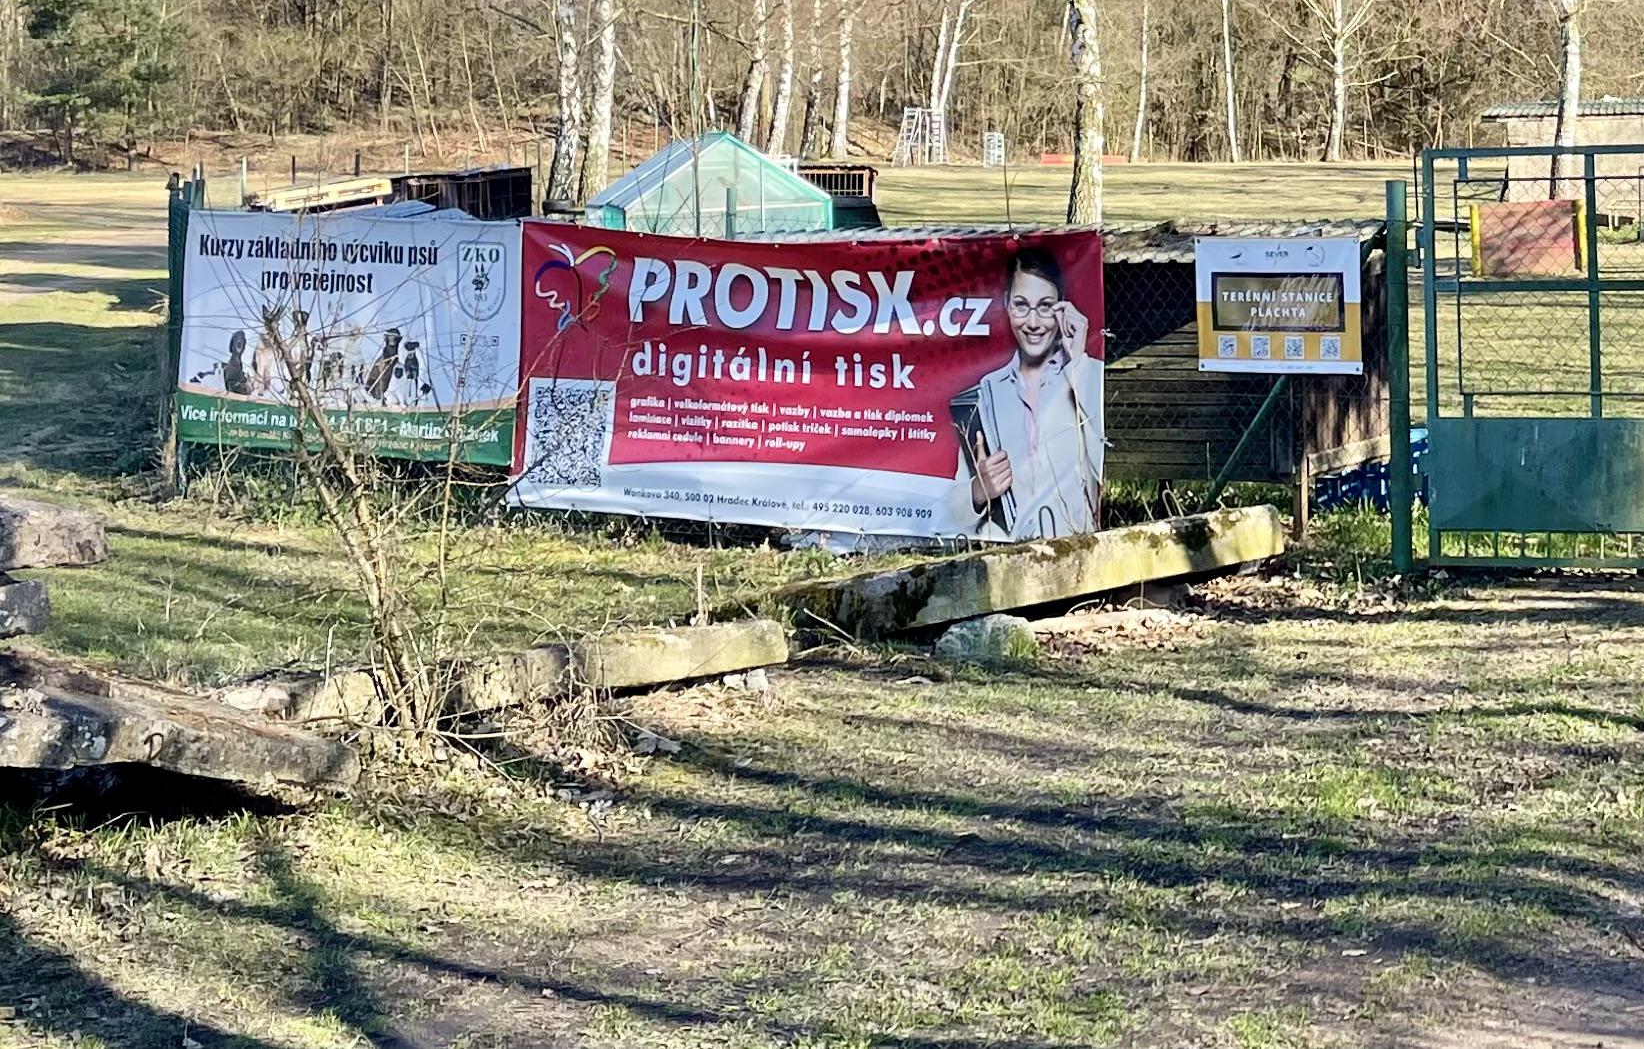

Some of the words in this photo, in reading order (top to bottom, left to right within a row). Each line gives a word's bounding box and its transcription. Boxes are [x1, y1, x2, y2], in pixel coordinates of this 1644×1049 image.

[200, 234, 244, 259] Kurzy
[247, 235, 337, 262] základního
[341, 238, 404, 264] výcviku
[407, 240, 439, 267] psů
[461, 247, 500, 263] ZKO
[261, 269, 290, 292] pro
[293, 267, 374, 294] veřejnost
[628, 256, 994, 337] PROTISK.cz
[1222, 289, 1277, 302] TERÉNNÍ
[1281, 292, 1333, 302] STANICE
[1250, 307, 1306, 318] PLACHTA
[631, 341, 813, 387] digitální
[835, 352, 916, 389] tisk
[271, 414, 287, 427] na
[630, 395, 665, 409] grafika
[673, 398, 749, 415] velkoformátový
[750, 402, 770, 415] tisk
[779, 404, 811, 417] vazby
[820, 406, 852, 419] vazba
[853, 410, 862, 420] a
[863, 408, 883, 421] tisk
[884, 409, 934, 424] diplomek
[681, 414, 713, 429] vizitky
[768, 421, 800, 434] potisk
[841, 425, 899, 440] samolepky
[907, 428, 937, 443] štítky
[712, 432, 756, 449] bannery
[764, 436, 806, 452] roll-upy
[664, 490, 682, 502] 340,
[684, 492, 701, 503] 500
[703, 493, 715, 504] 02
[717, 494, 750, 506] Hradec
[751, 496, 789, 511] Králové,
[811, 501, 830, 512] 495
[831, 503, 850, 514] 220
[852, 504, 873, 517] 028,
[875, 506, 894, 517] 603
[895, 507, 913, 518] 908
[915, 508, 933, 519] 909
